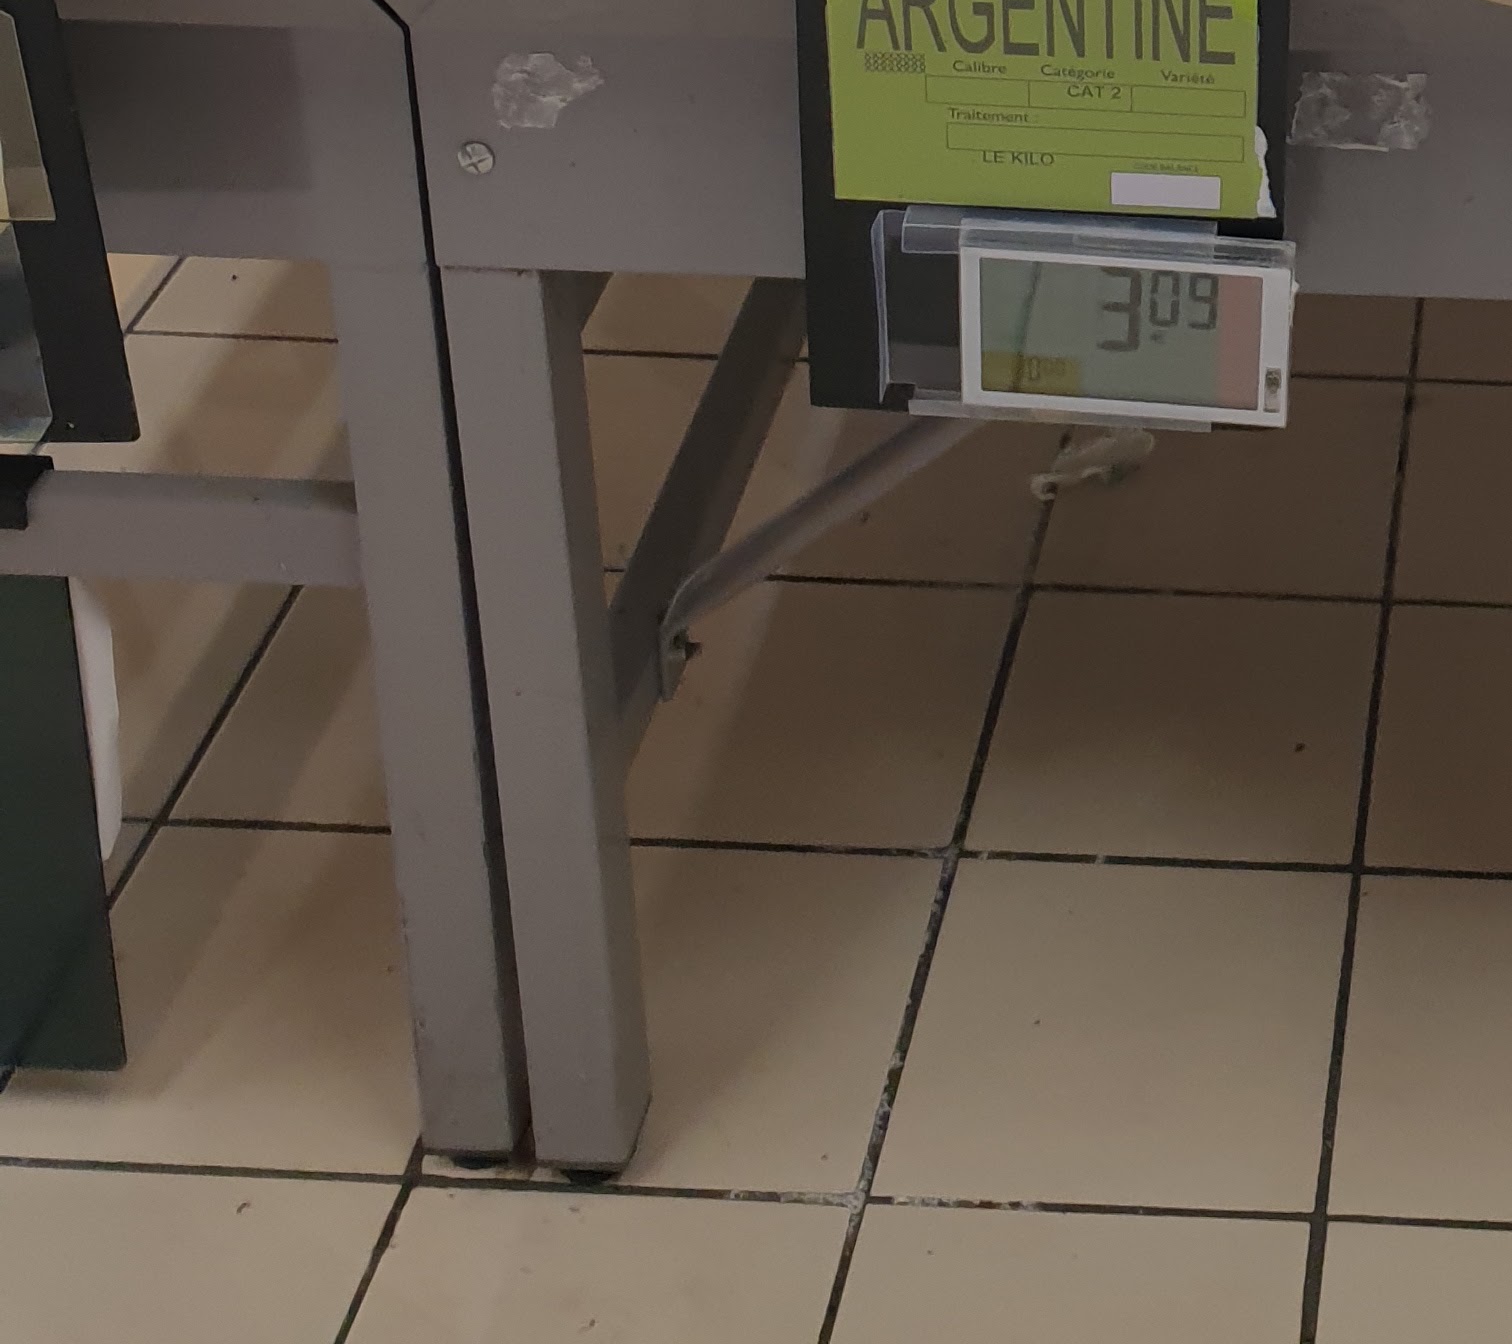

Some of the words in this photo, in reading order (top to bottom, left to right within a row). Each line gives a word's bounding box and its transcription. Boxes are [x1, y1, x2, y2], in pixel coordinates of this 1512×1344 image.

[952, 60, 1007, 75] Calibre
[1041, 64, 1116, 81] Catégorie
[1160, 69, 1216, 85] Variété
[1067, 85, 1104, 99] CAT
[1111, 87, 1122, 100] 2
[949, 107, 1030, 123] Traitement
[982, 151, 1001, 163] LE
[1011, 152, 1055, 166] KILO
